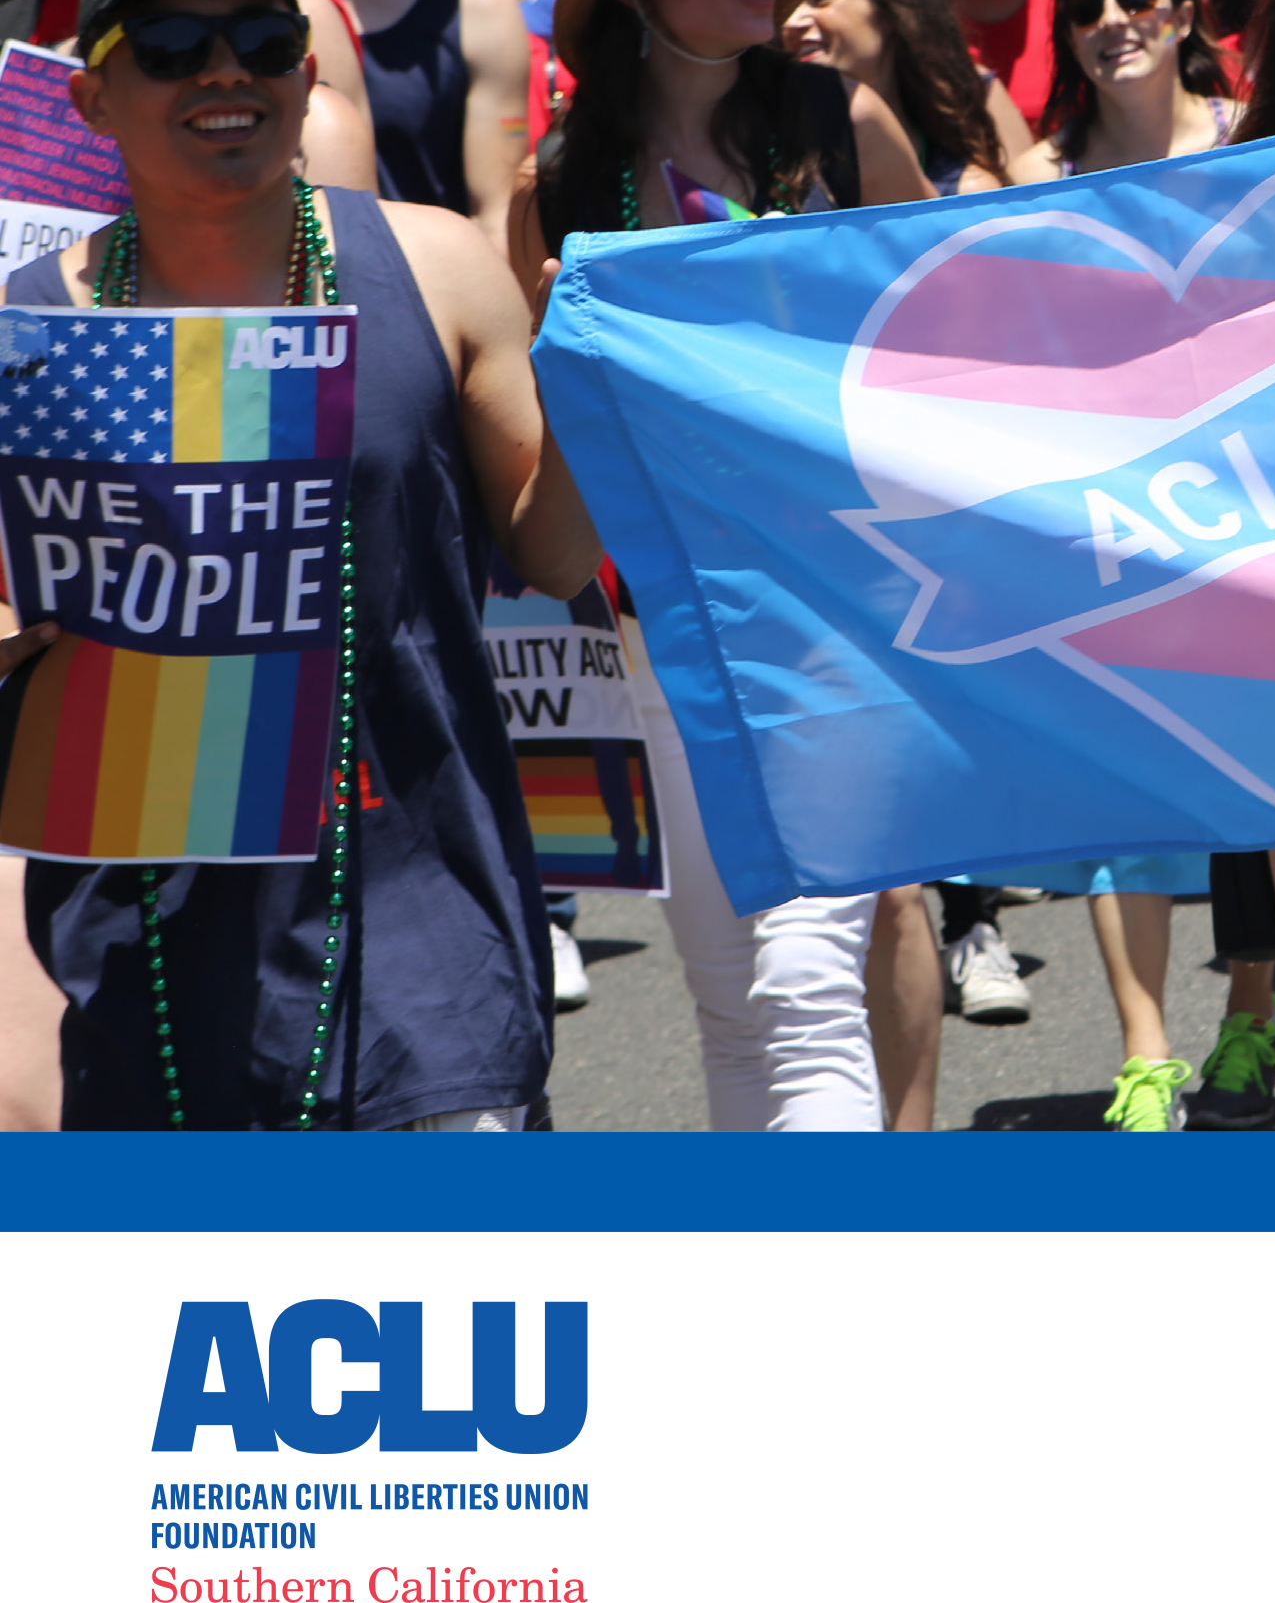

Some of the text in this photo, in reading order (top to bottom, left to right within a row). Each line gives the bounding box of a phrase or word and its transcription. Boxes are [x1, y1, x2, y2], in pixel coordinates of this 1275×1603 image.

[18, 222, 83, 264] PRO
[229, 325, 348, 370] ACLU
[17, 475, 333, 535] WE THE
[32, 534, 326, 637] PEOPLE
[580, 637, 626, 680] ACT
